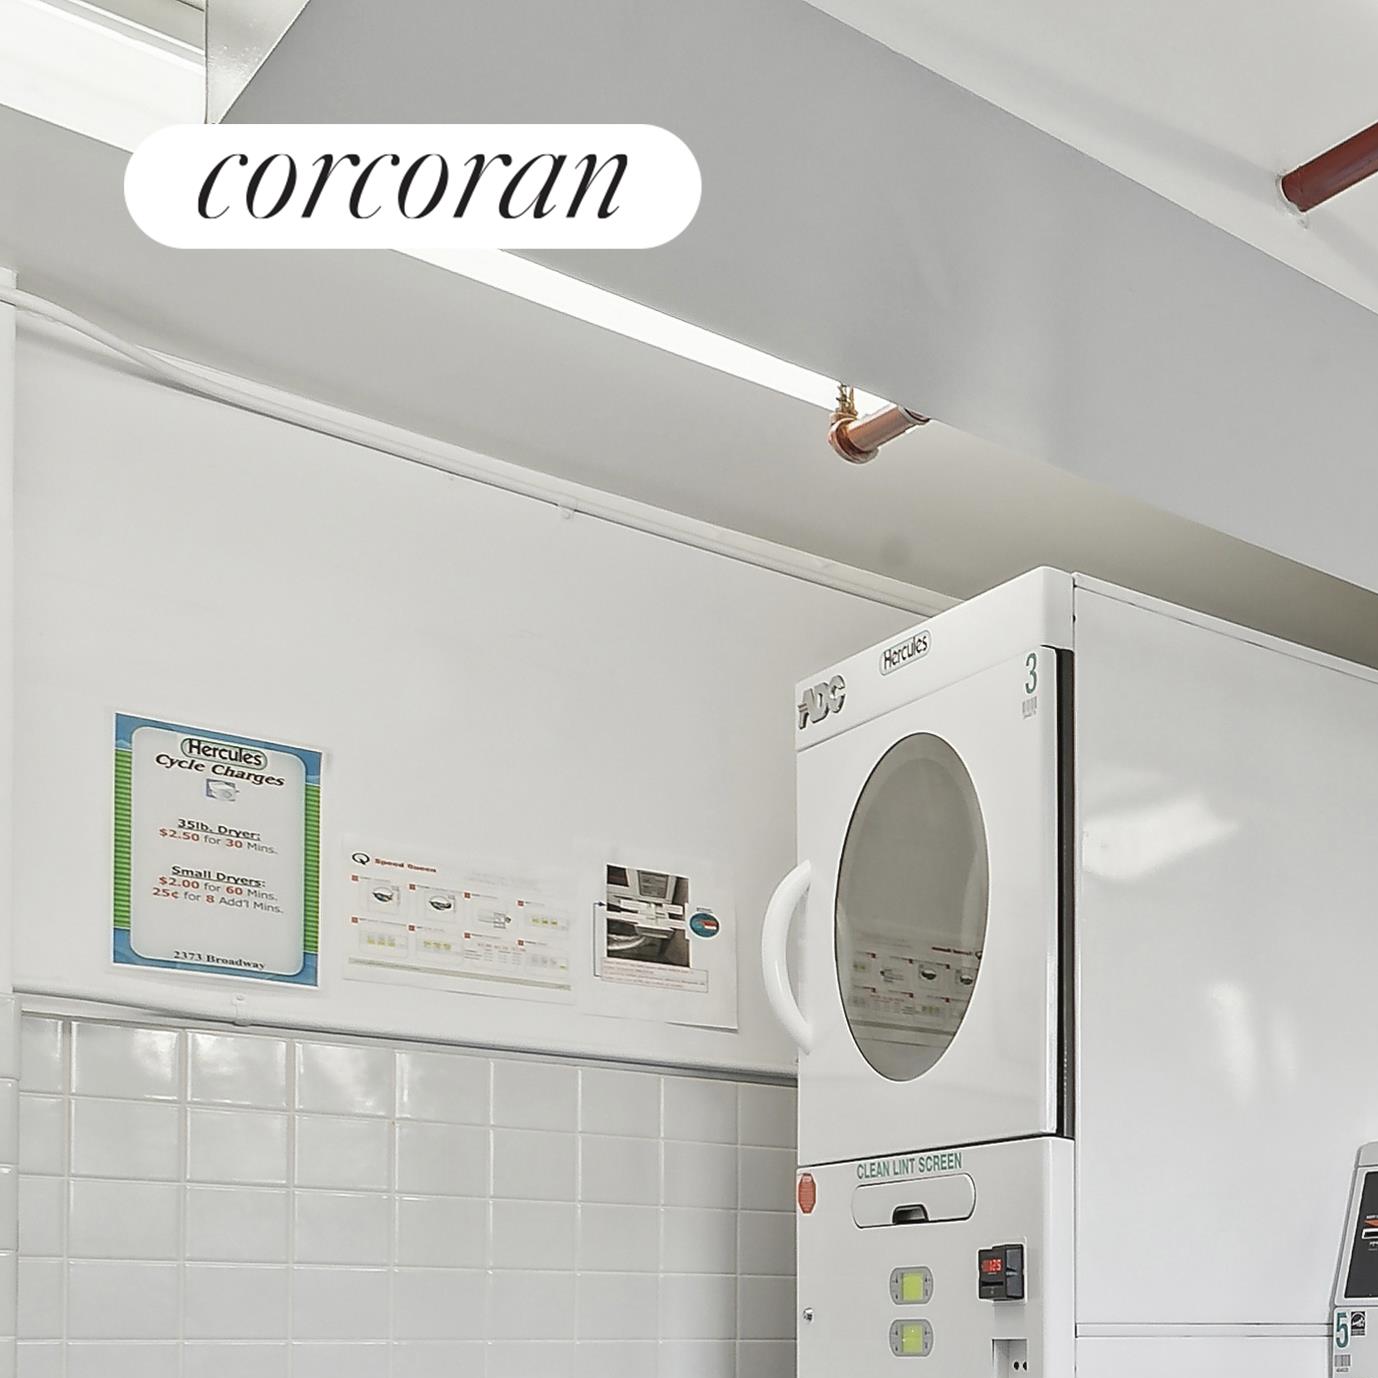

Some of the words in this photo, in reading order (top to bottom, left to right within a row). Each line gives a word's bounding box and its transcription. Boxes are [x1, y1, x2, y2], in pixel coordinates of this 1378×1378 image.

[883, 635, 928, 671] Hercules
[1025, 654, 1037, 694] 3
[799, 674, 846, 729] ADC
[188, 739, 262, 766] Hercules
[156, 754, 205, 772] Cycle
[211, 764, 285, 787] Charges
[160, 828, 199, 842] $2.50
[204, 835, 221, 845] for
[226, 839, 243, 848] 30
[248, 842, 278, 854] Mins.
[178, 818, 213, 833] 35lb.
[219, 824, 261, 840] Dryer:
[172, 865, 211, 880] Small
[217, 872, 266, 887] Dryers:
[375, 858, 404, 868] Speed
[408, 863, 436, 873] Queen
[152, 887, 179, 899] 25¢
[184, 892, 201, 901] for
[206, 895, 214, 903] 8
[254, 902, 284, 913] Mins.
[159, 876, 199, 889] $2.00
[204, 882, 221, 892] for
[226, 886, 243, 895] 60
[248, 889, 278, 901] Mins.
[174, 951, 202, 961] 2373
[207, 955, 265, 969] Broadway
[857, 1157, 891, 1180] CLEAN
[893, 1157, 916, 1177] LINT
[918, 1152, 963, 1172] SCREEN
[1336, 1312, 1348, 1348] 5
